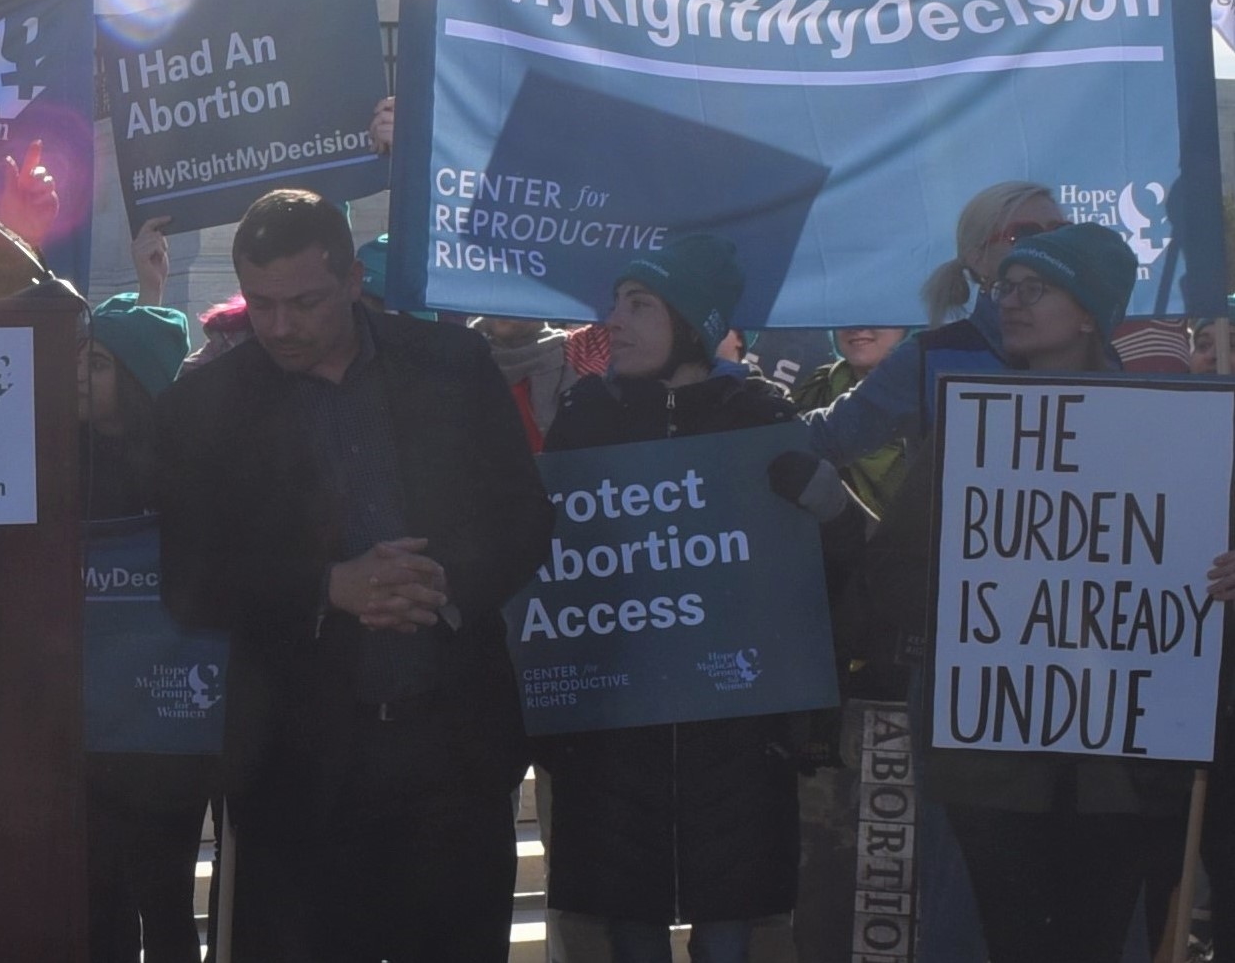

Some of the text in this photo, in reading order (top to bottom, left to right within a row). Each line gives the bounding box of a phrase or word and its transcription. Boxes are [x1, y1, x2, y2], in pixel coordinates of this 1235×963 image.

[118, 32, 277, 93] I Had An
[126, 79, 291, 139] Abortion
[132, 130, 374, 191] #MyRightMyDecision
[436, 167, 611, 211] CENTER for
[1060, 184, 1117, 211] Hope
[436, 204, 668, 251] REPRODUCTIVE
[1066, 206, 1118, 226] dical
[436, 240, 547, 278] RIGHTS
[959, 392, 1085, 473] THE
[548, 469, 706, 522] otect
[962, 486, 1165, 566] BURDEN
[521, 593, 705, 642] Access
[959, 580, 1215, 657] IS ALREADY
[153, 665, 188, 680] Hope
[523, 665, 578, 681] CENTER
[708, 650, 735, 662] Hope
[134, 676, 187, 688] Medical
[151, 688, 192, 702] Group
[525, 674, 629, 695] REPRODUCTIVE
[526, 693, 577, 708] RIGHTS
[157, 707, 206, 718] Women
[950, 665, 1152, 755] UNDUE
[863, 715, 911, 963] ABORTIO
